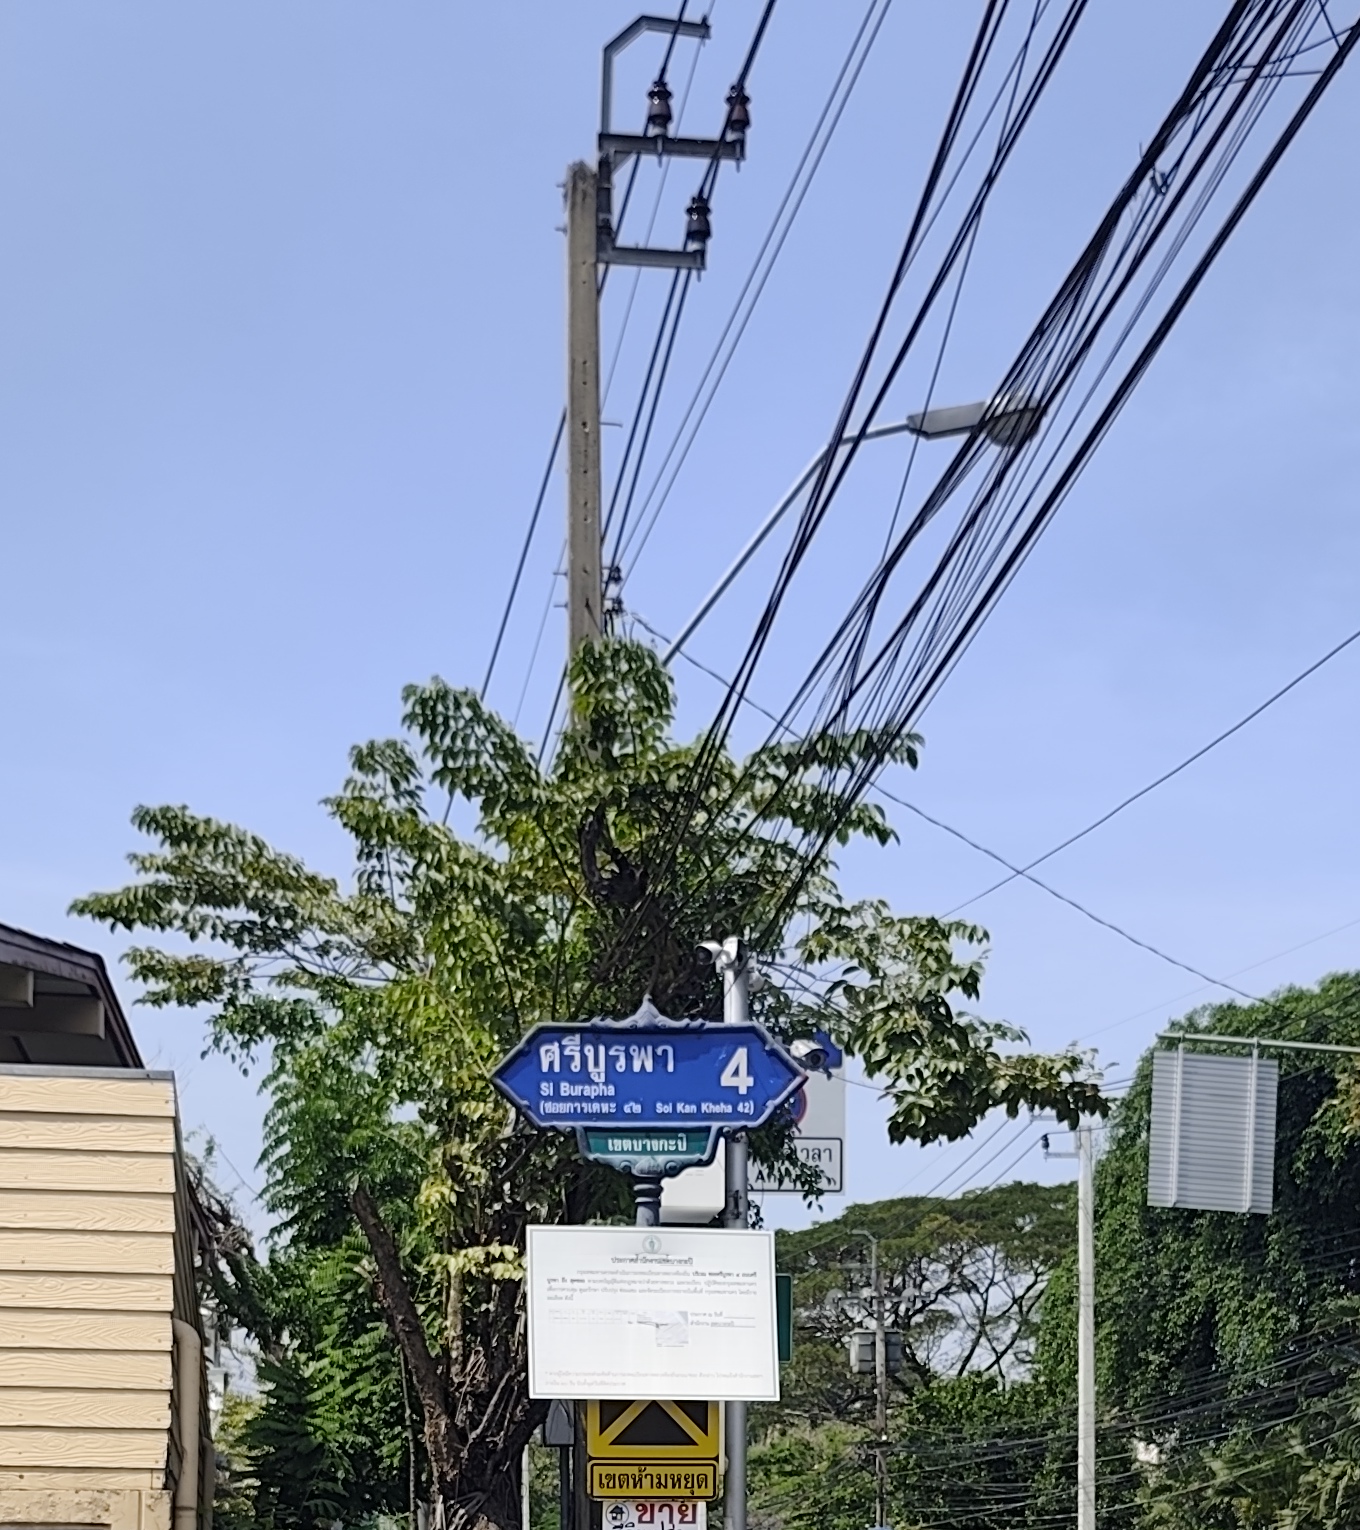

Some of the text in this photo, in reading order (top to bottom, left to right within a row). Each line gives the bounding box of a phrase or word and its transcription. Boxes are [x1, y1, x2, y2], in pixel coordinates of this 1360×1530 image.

[539, 1033, 754, 1095] ศรีบูรพา 4
[540, 1082, 615, 1099] Si Burapha
[656, 1102, 672, 1113] Soi
[677, 1102, 697, 1113] Kan
[701, 1102, 732, 1113] Kheha
[737, 1101, 754, 1115] 42)
[607, 1133, 687, 1152] เขตบางกะปิ
[599, 1467, 708, 1495] เขตห้ามหยุด
[635, 1502, 697, 1525] ขาย
